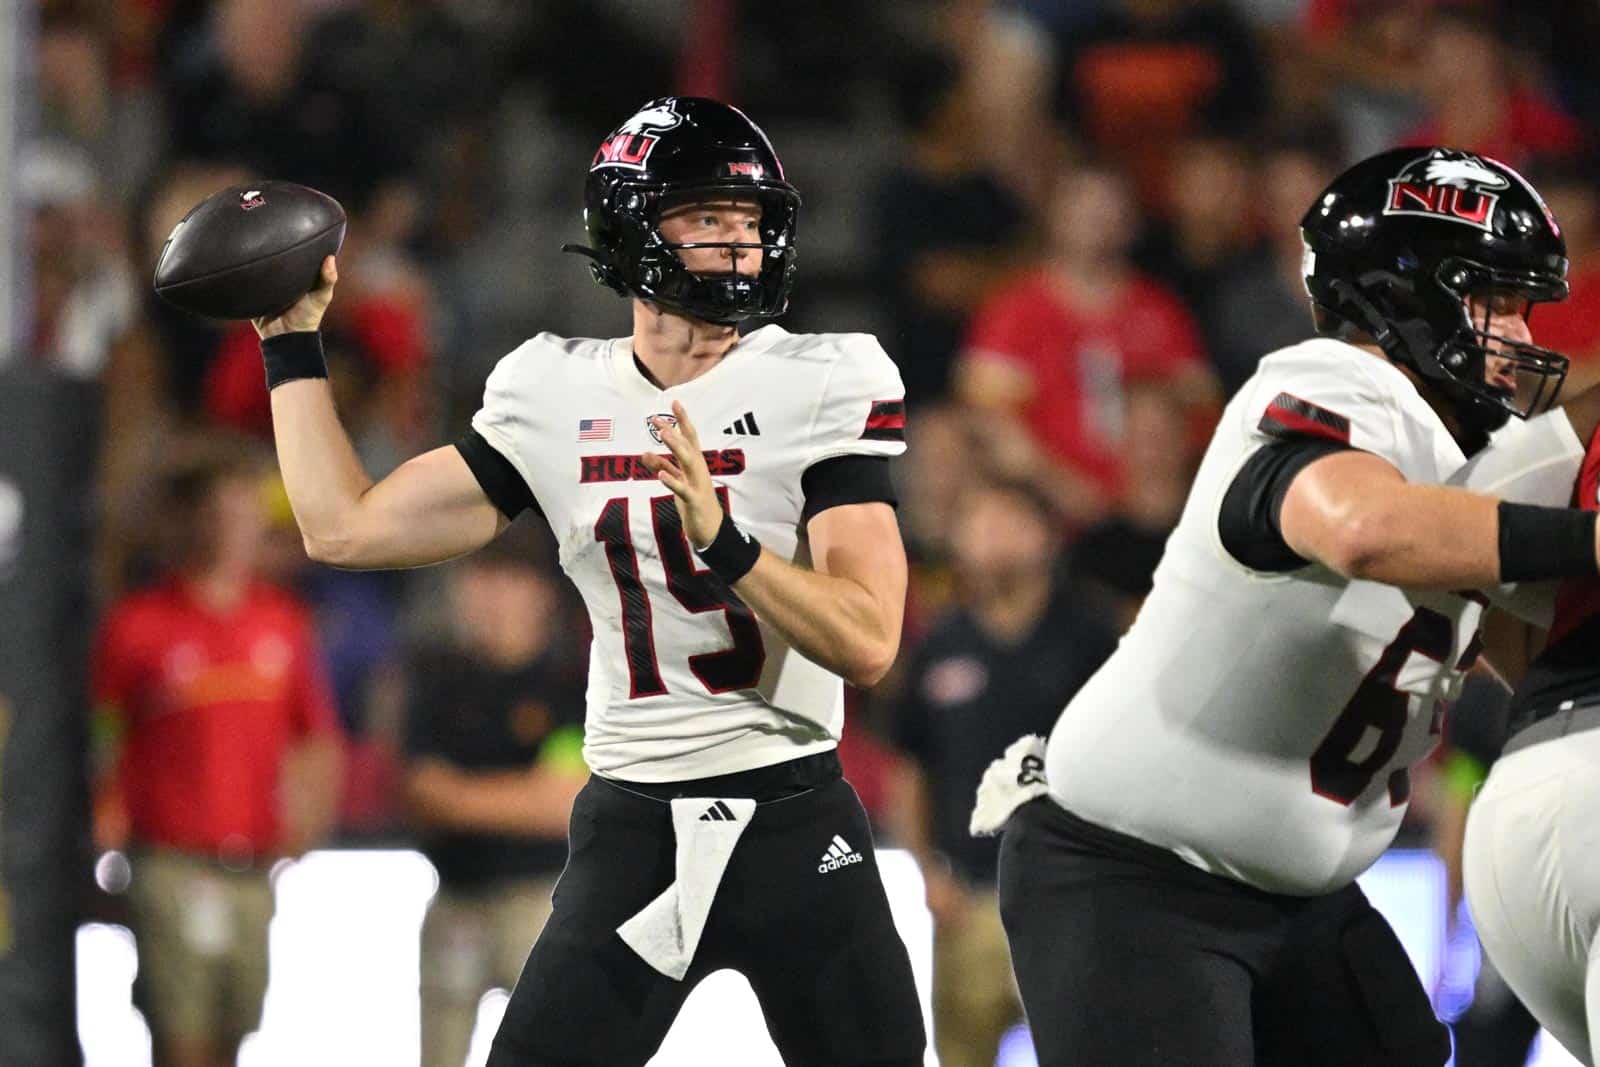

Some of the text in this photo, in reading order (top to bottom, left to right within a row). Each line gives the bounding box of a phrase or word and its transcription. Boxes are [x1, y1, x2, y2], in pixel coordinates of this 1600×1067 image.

[1393, 183, 1492, 224] NIU
[581, 449, 745, 483] HUSES
[594, 486, 766, 699] 15
[818, 852, 863, 873] adidas
